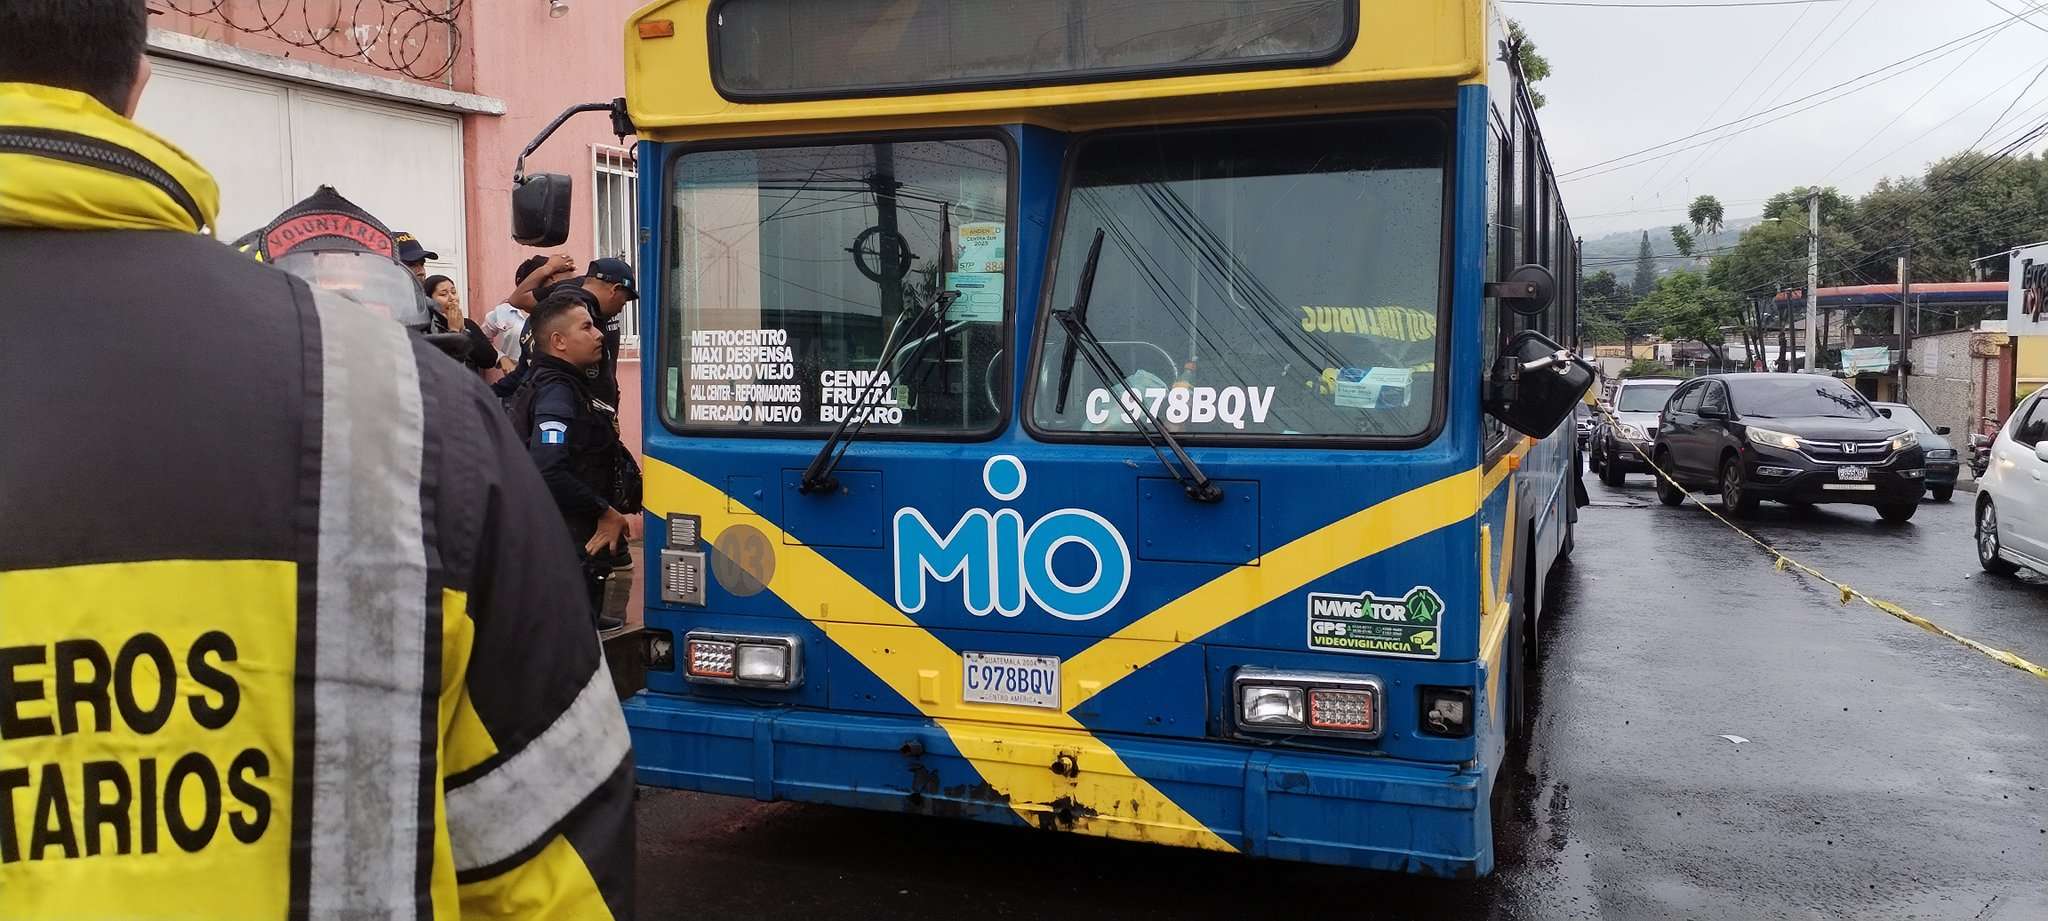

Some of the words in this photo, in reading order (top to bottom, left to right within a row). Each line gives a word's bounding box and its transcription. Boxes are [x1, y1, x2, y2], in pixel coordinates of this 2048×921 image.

[270, 217, 390, 250] VOLUNTARIO
[691, 329, 787, 346] METROCENTRO
[691, 347, 722, 363] MAXI
[726, 347, 794, 363] DESPENSA
[691, 364, 752, 380] MERCADO
[755, 364, 794, 380] VIEJO
[820, 370, 891, 387] CENMA
[691, 385, 705, 401] CALL
[707, 385, 730, 401] CENTER
[735, 385, 801, 403] REFORMADORES
[822, 387, 898, 404] FRUTAL
[690, 405, 752, 421] MERCADO
[755, 406, 802, 423] NUEVO
[820, 406, 903, 424] BUCARO
[1120, 386, 1276, 430] 978BQV
[1314, 599, 1407, 621] NAVIGATOR
[1312, 622, 1347, 635] GPS
[1314, 636, 1411, 651] VIDEOVIGILANCIA
[984, 656, 1020, 665] GUATEMALA
[0, 630, 240, 740] EROS
[0, 748, 272, 863] TARIOS
